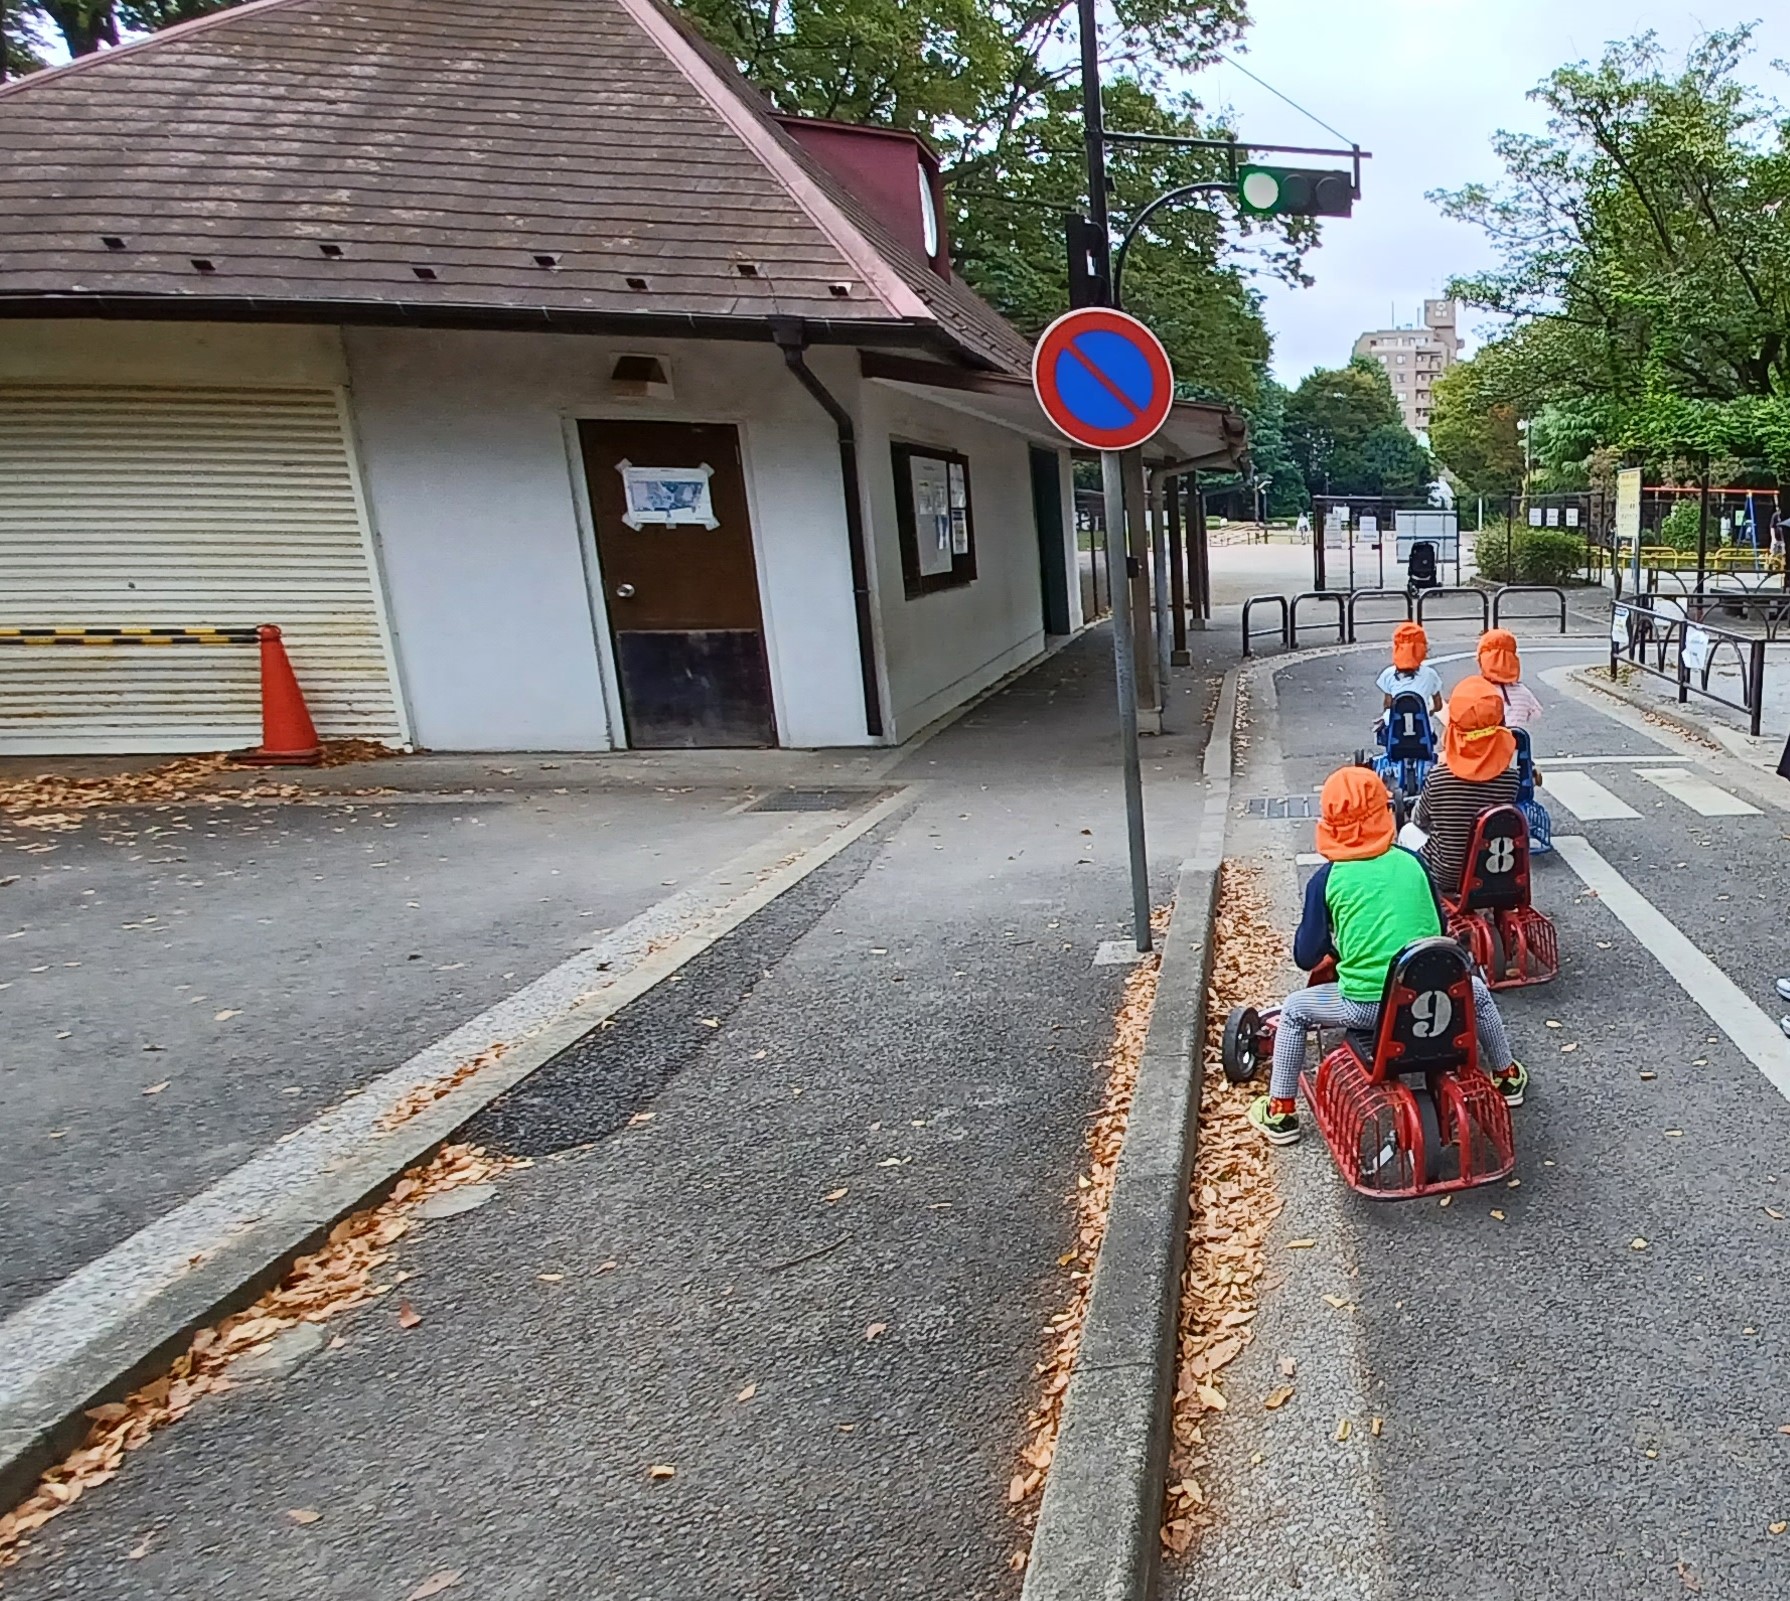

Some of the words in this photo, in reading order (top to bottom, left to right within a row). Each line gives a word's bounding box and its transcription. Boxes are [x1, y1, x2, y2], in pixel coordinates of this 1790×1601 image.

[1403, 712, 1416, 736] 1
[1486, 837, 1514, 873] 8
[1411, 990, 1452, 1037] 9
